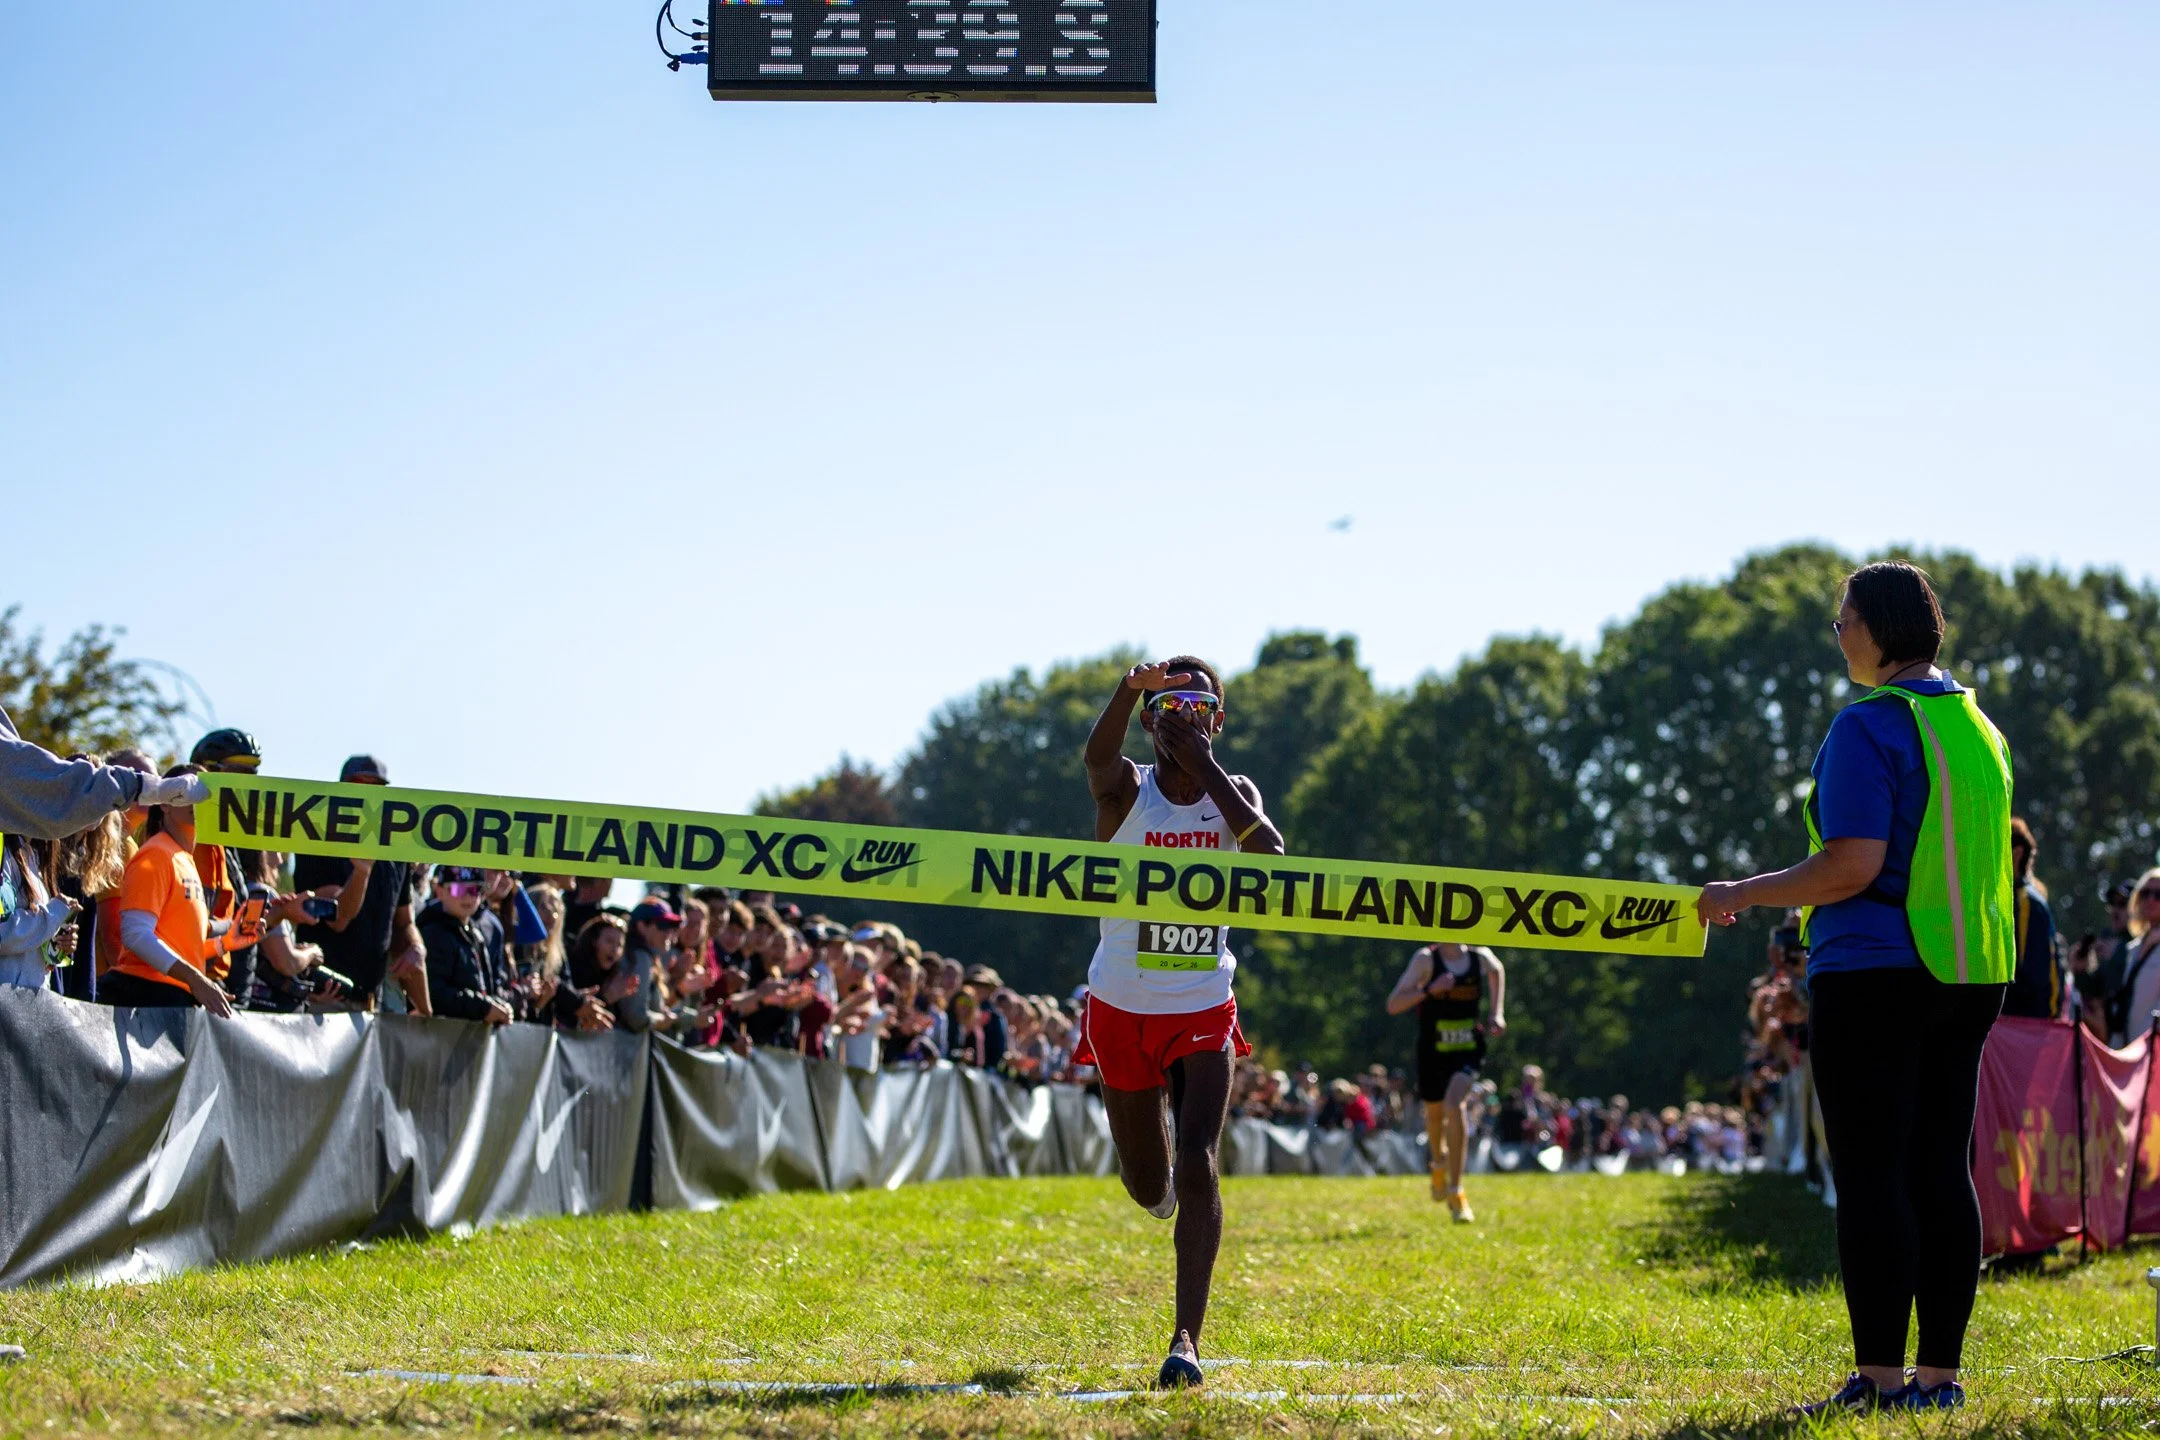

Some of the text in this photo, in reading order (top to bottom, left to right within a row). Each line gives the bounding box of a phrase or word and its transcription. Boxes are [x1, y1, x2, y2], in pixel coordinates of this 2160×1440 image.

[219, 787, 827, 880] NIKE PORTLAND XC
[1144, 831, 1220, 848] NORTH
[856, 839, 917, 865] RUN
[971, 847, 1587, 938] NIKE PORTLAND XC
[1616, 896, 1676, 922] RUN
[1149, 924, 1214, 953] 1902
